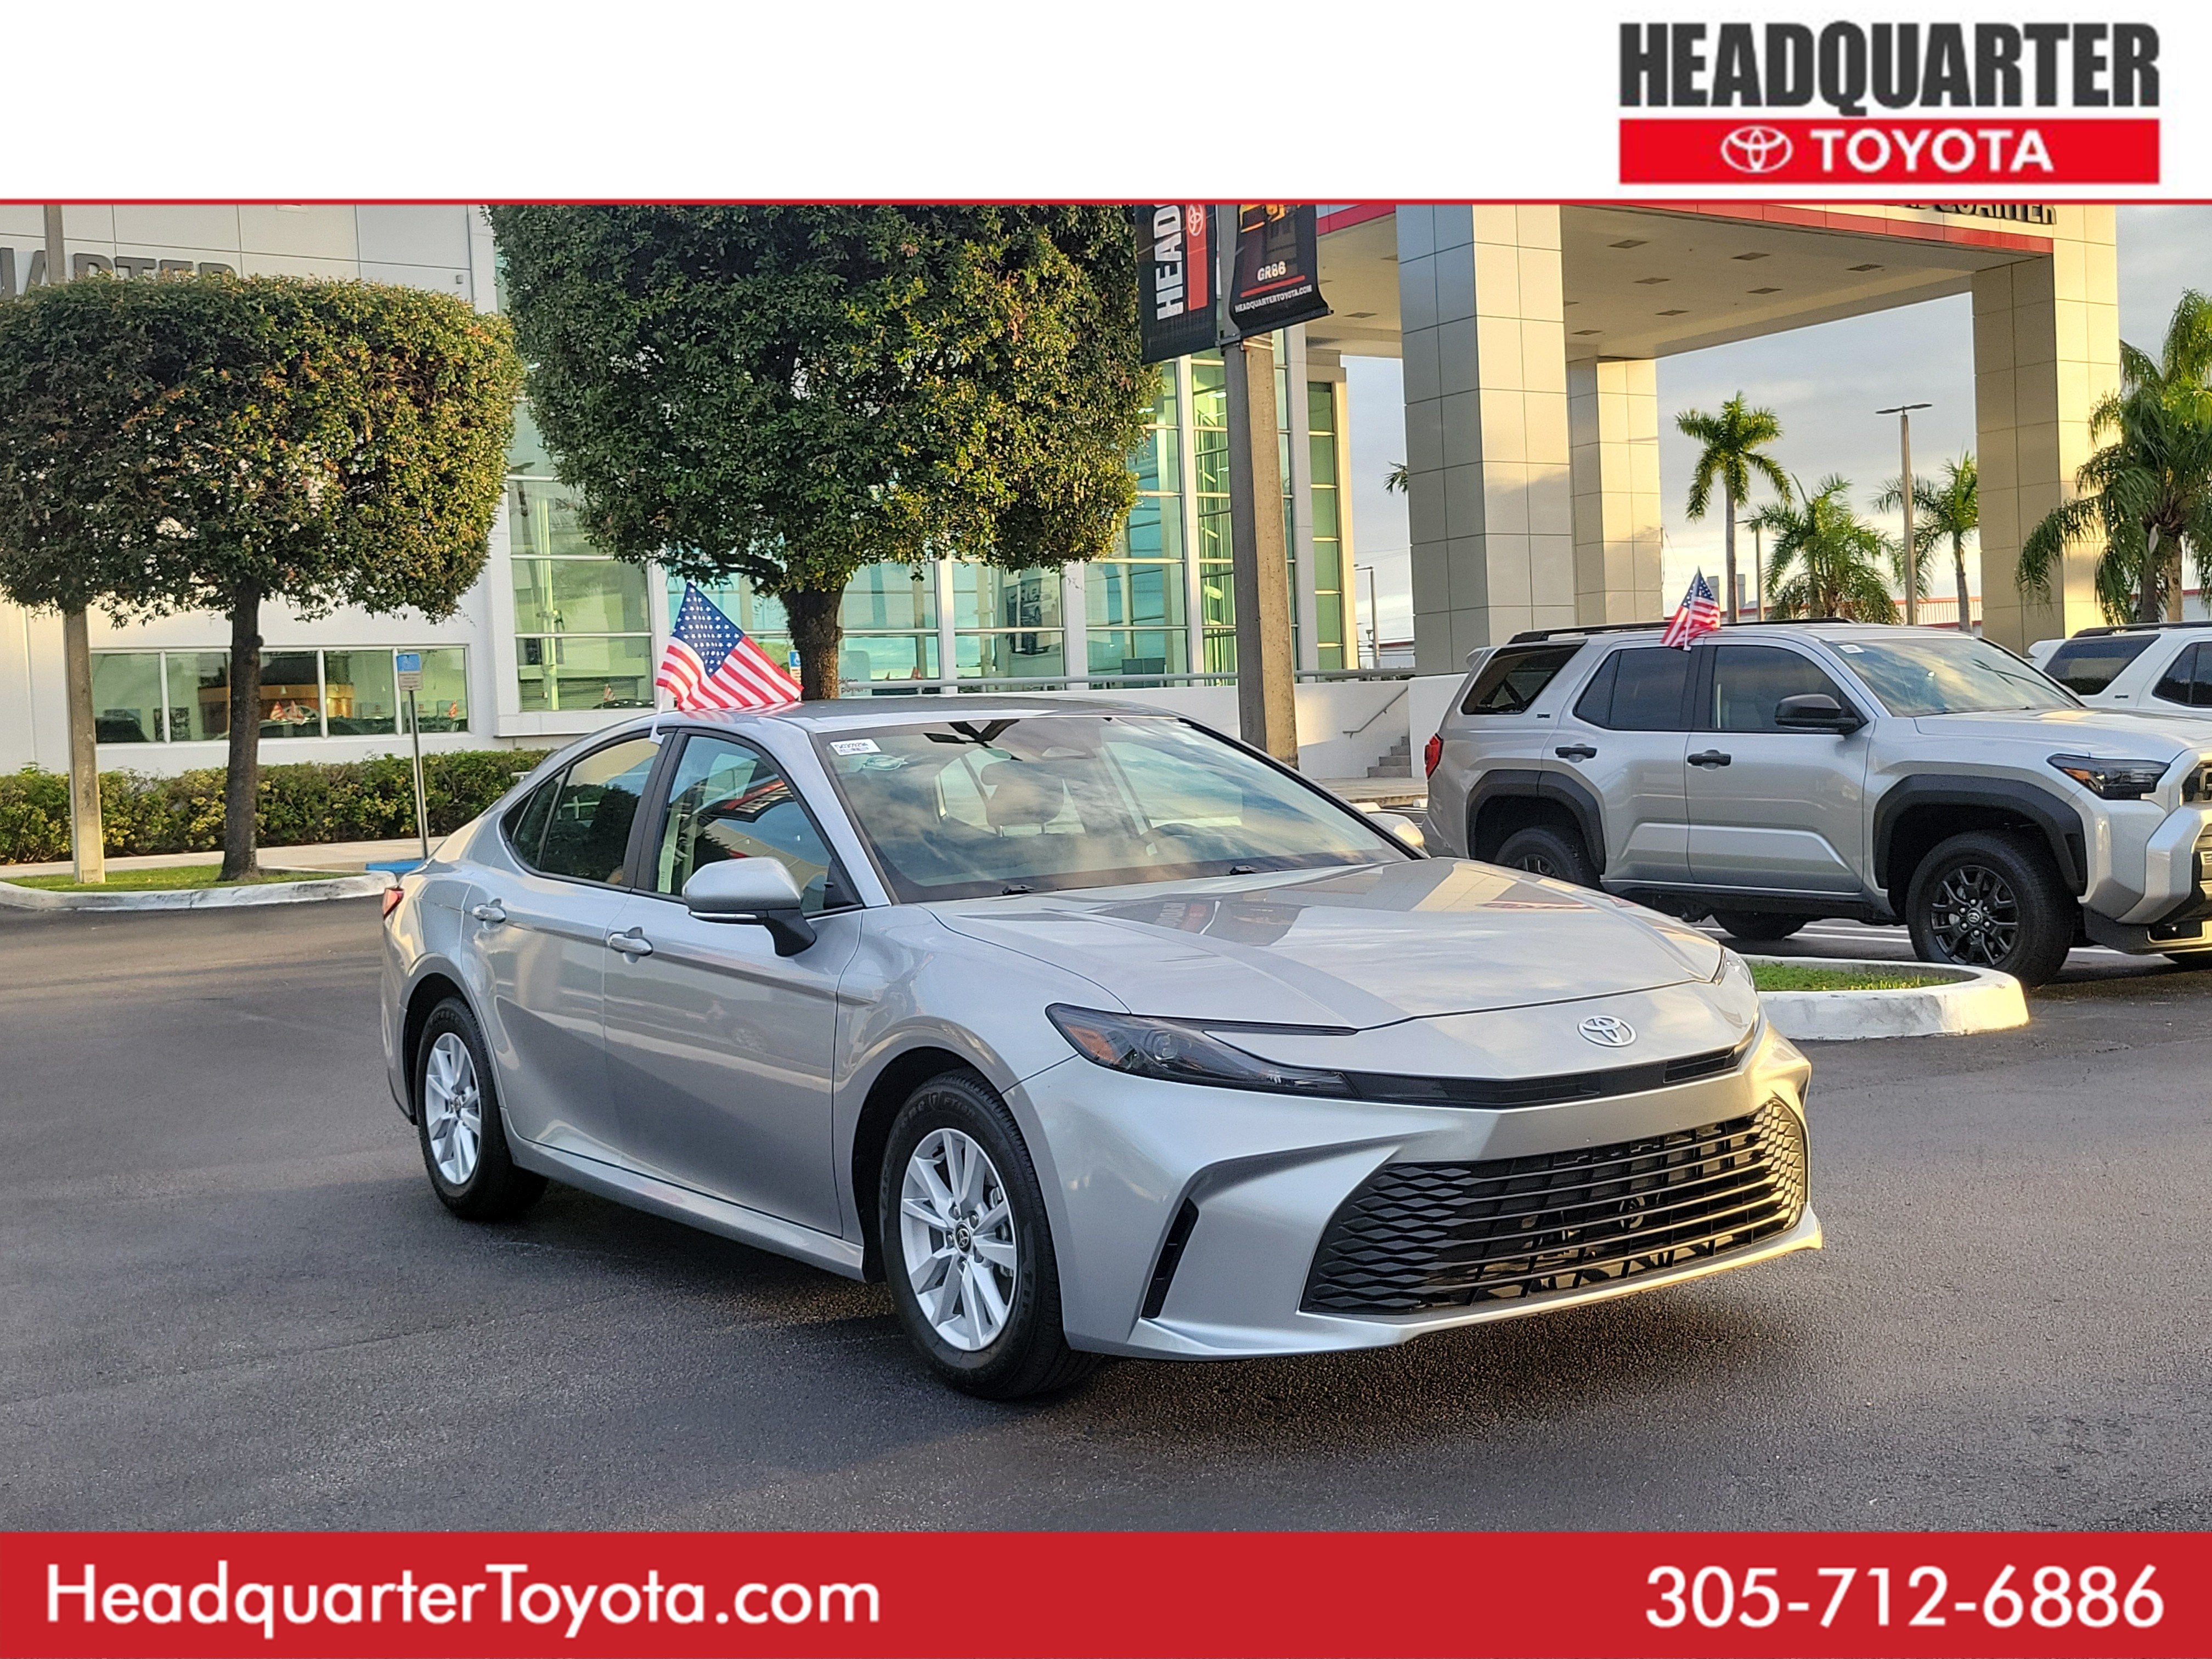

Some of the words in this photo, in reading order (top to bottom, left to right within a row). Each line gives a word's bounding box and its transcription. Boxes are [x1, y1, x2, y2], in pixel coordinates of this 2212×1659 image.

[1154, 204, 1184, 320] HEAD
[1257, 260, 1286, 281] GR86
[1234, 284, 1313, 313] HEADQUARTERTOYOTA.COM
